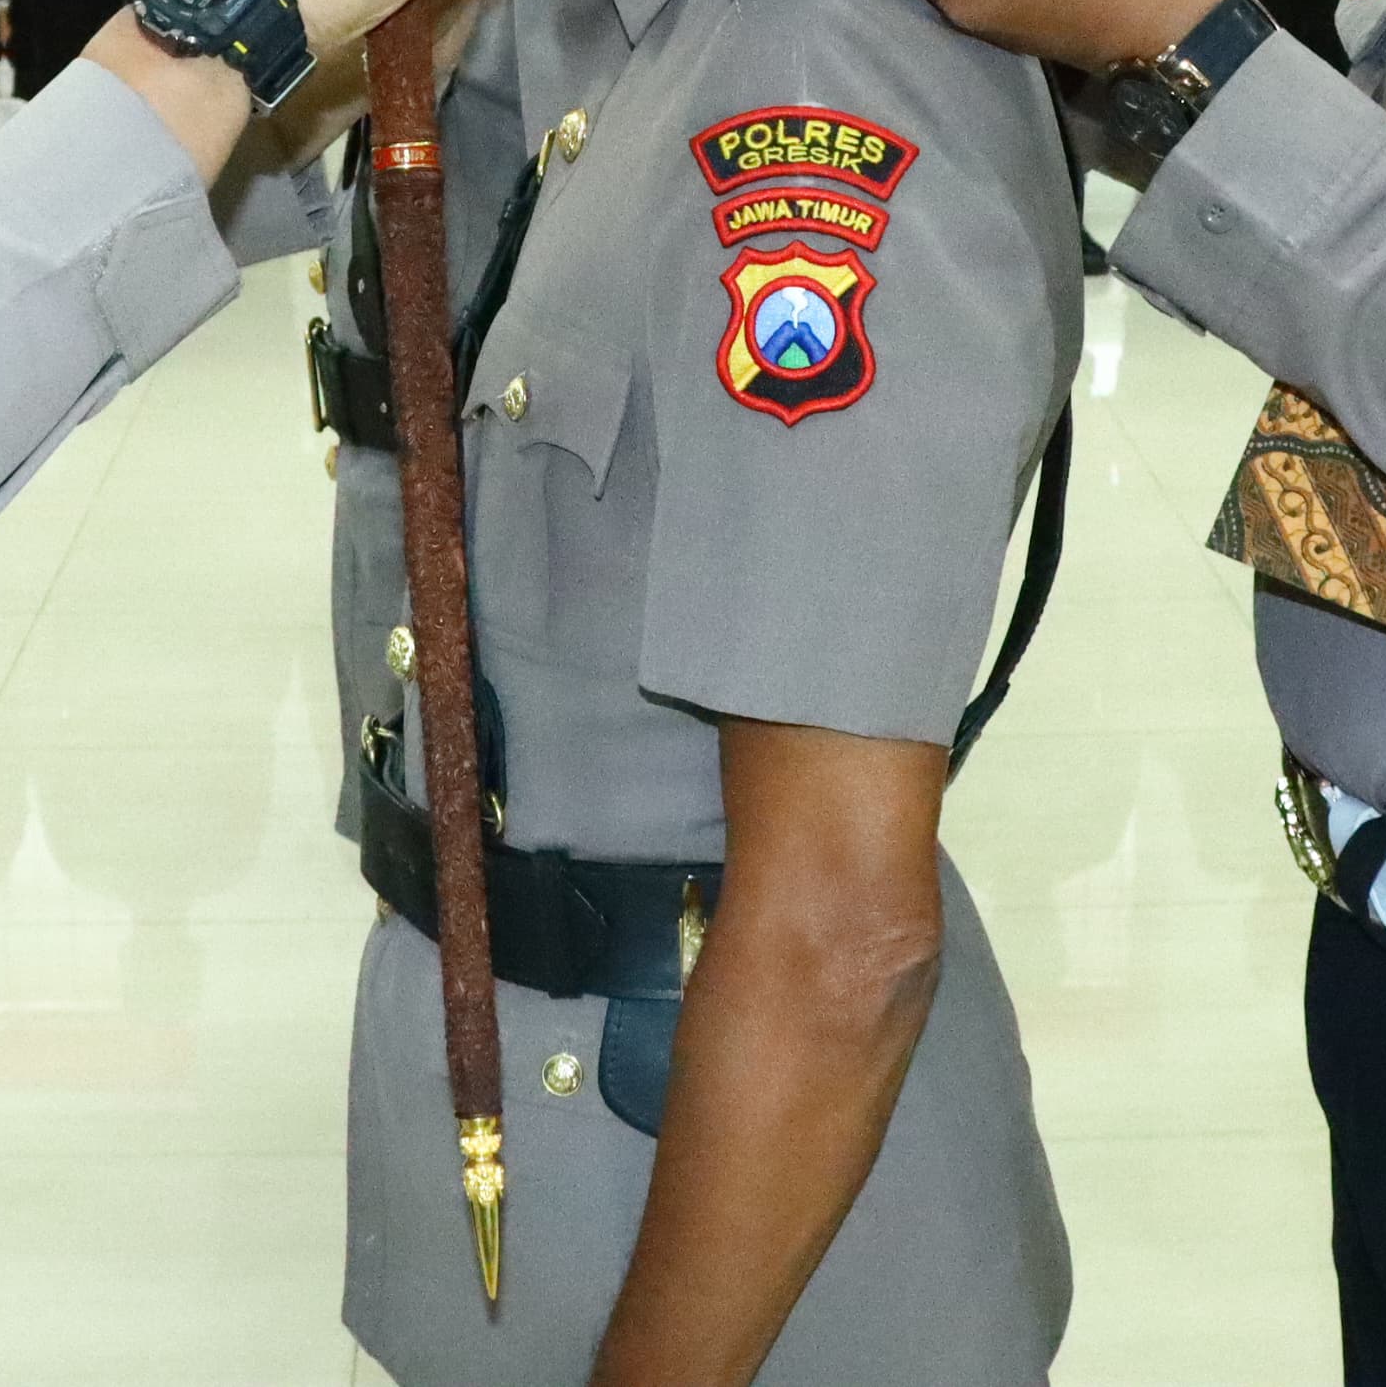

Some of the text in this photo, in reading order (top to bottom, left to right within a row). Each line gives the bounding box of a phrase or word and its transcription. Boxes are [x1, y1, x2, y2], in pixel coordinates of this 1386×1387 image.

[718, 119, 886, 164] POLRES
[738, 145, 863, 175] GRESIK
[728, 198, 874, 235] JAWA TIMUR
